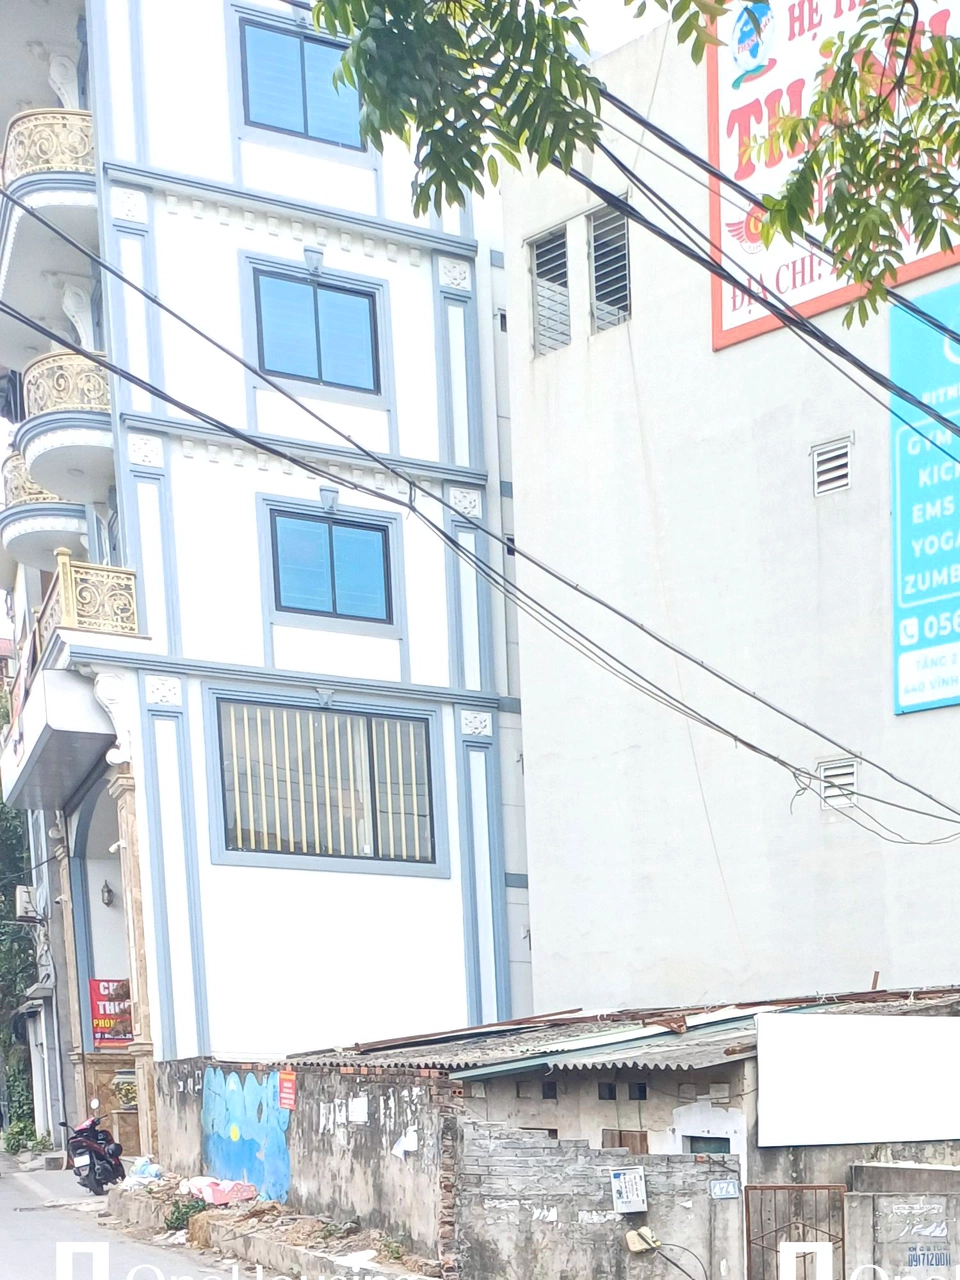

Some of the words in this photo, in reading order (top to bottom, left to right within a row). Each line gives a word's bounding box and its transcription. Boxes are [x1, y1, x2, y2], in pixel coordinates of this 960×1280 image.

[907, 428, 952, 456] GYM
[912, 496, 955, 524] EMS
[713, 1183, 736, 1196] 474
